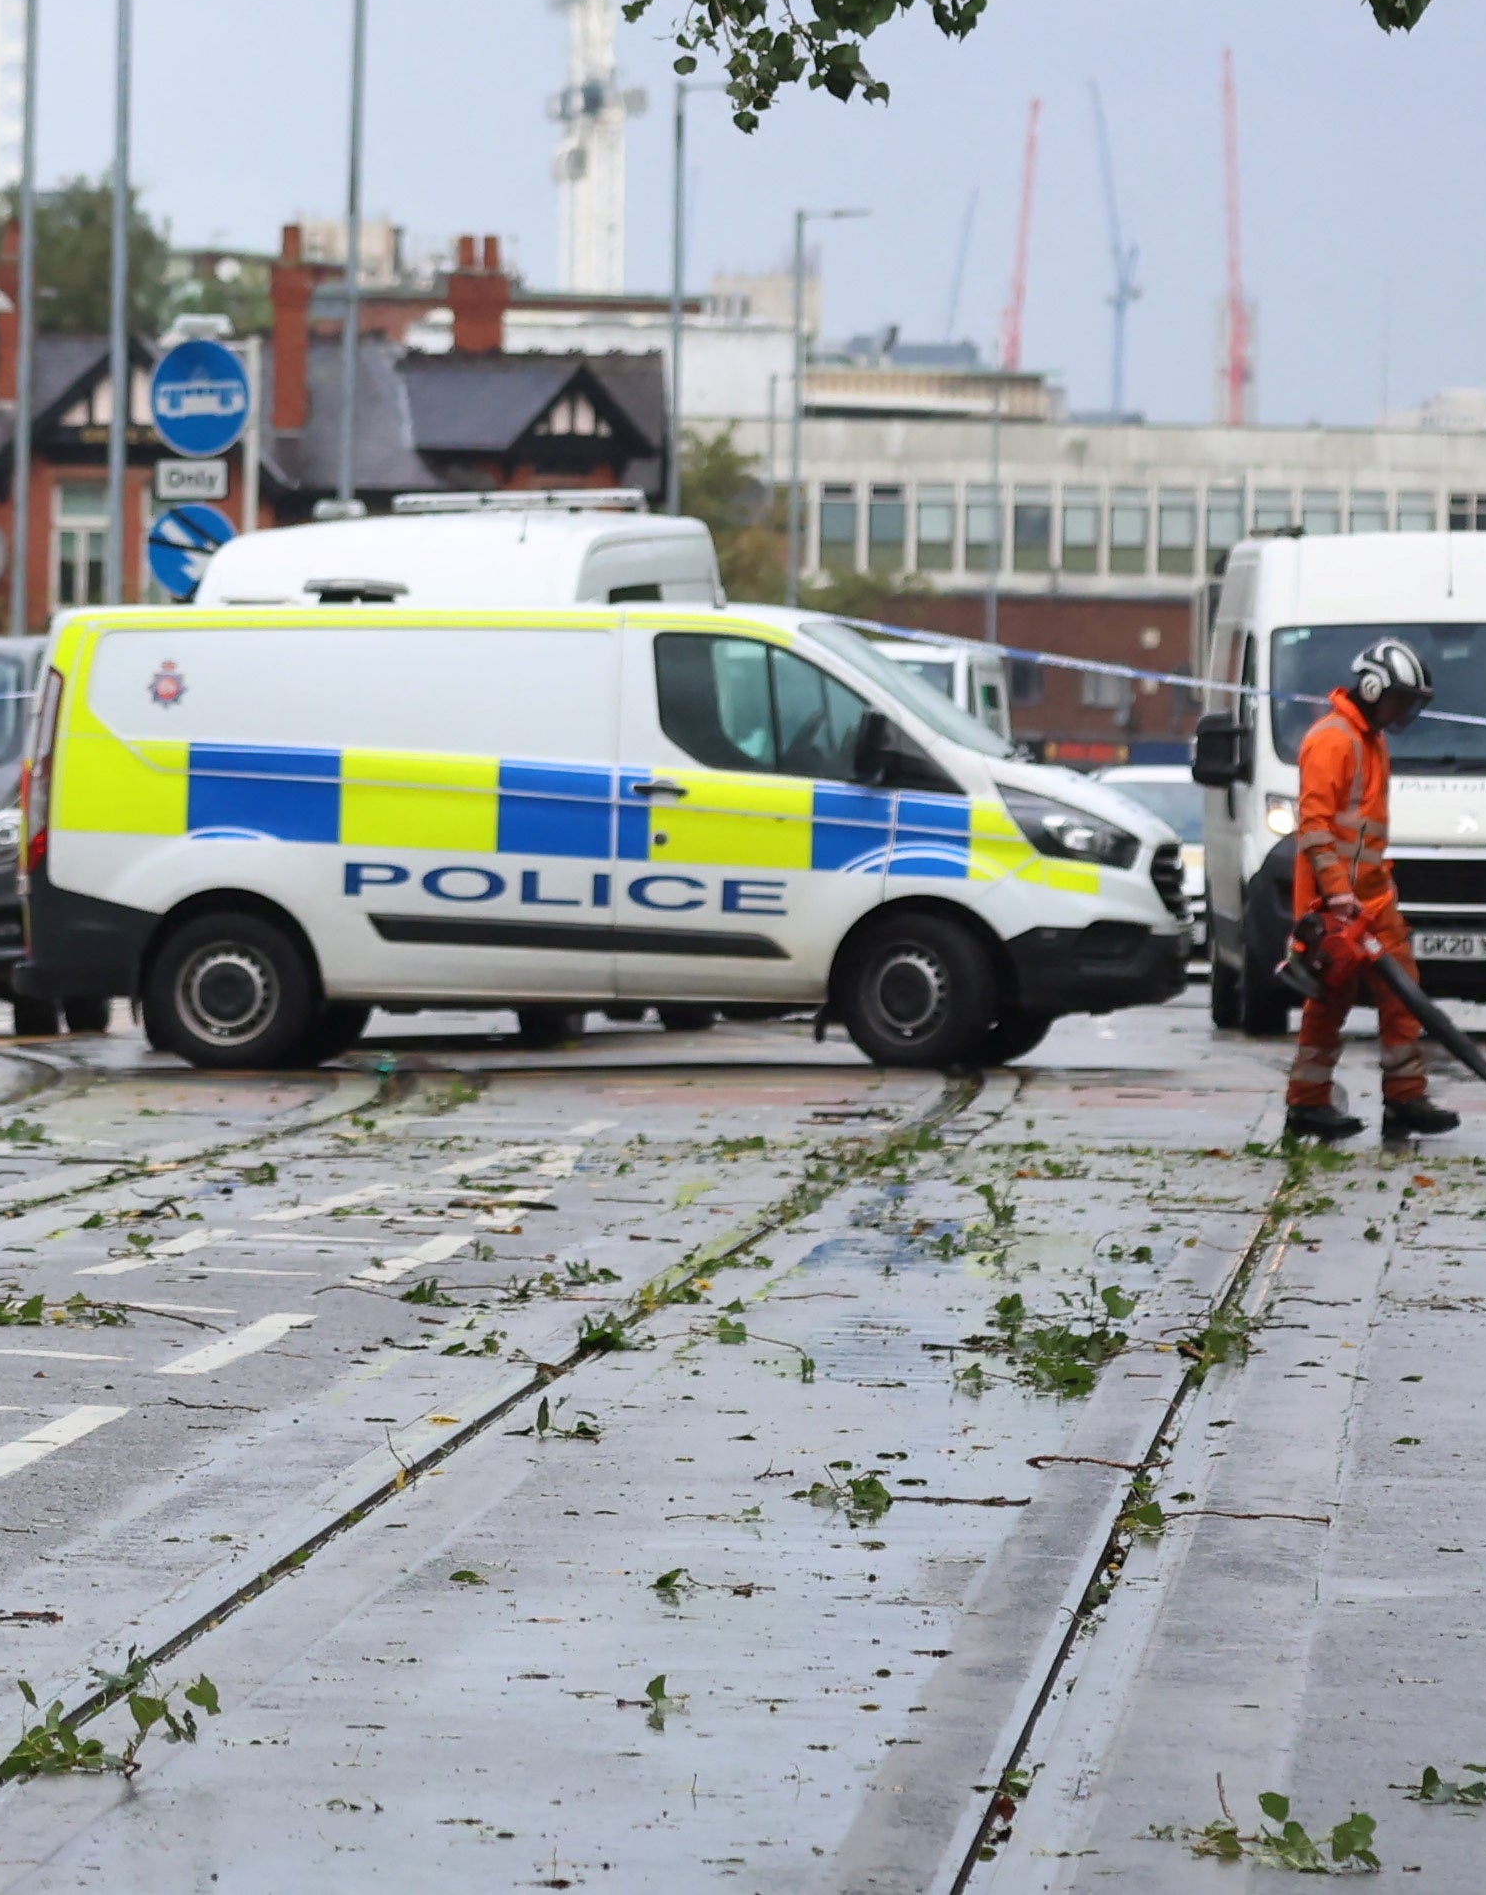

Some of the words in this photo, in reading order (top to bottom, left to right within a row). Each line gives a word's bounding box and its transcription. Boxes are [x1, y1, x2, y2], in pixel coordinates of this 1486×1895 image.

[168, 467, 218, 490] Only
[343, 862, 788, 916] POLICE
[1422, 935, 1474, 955] GK20
